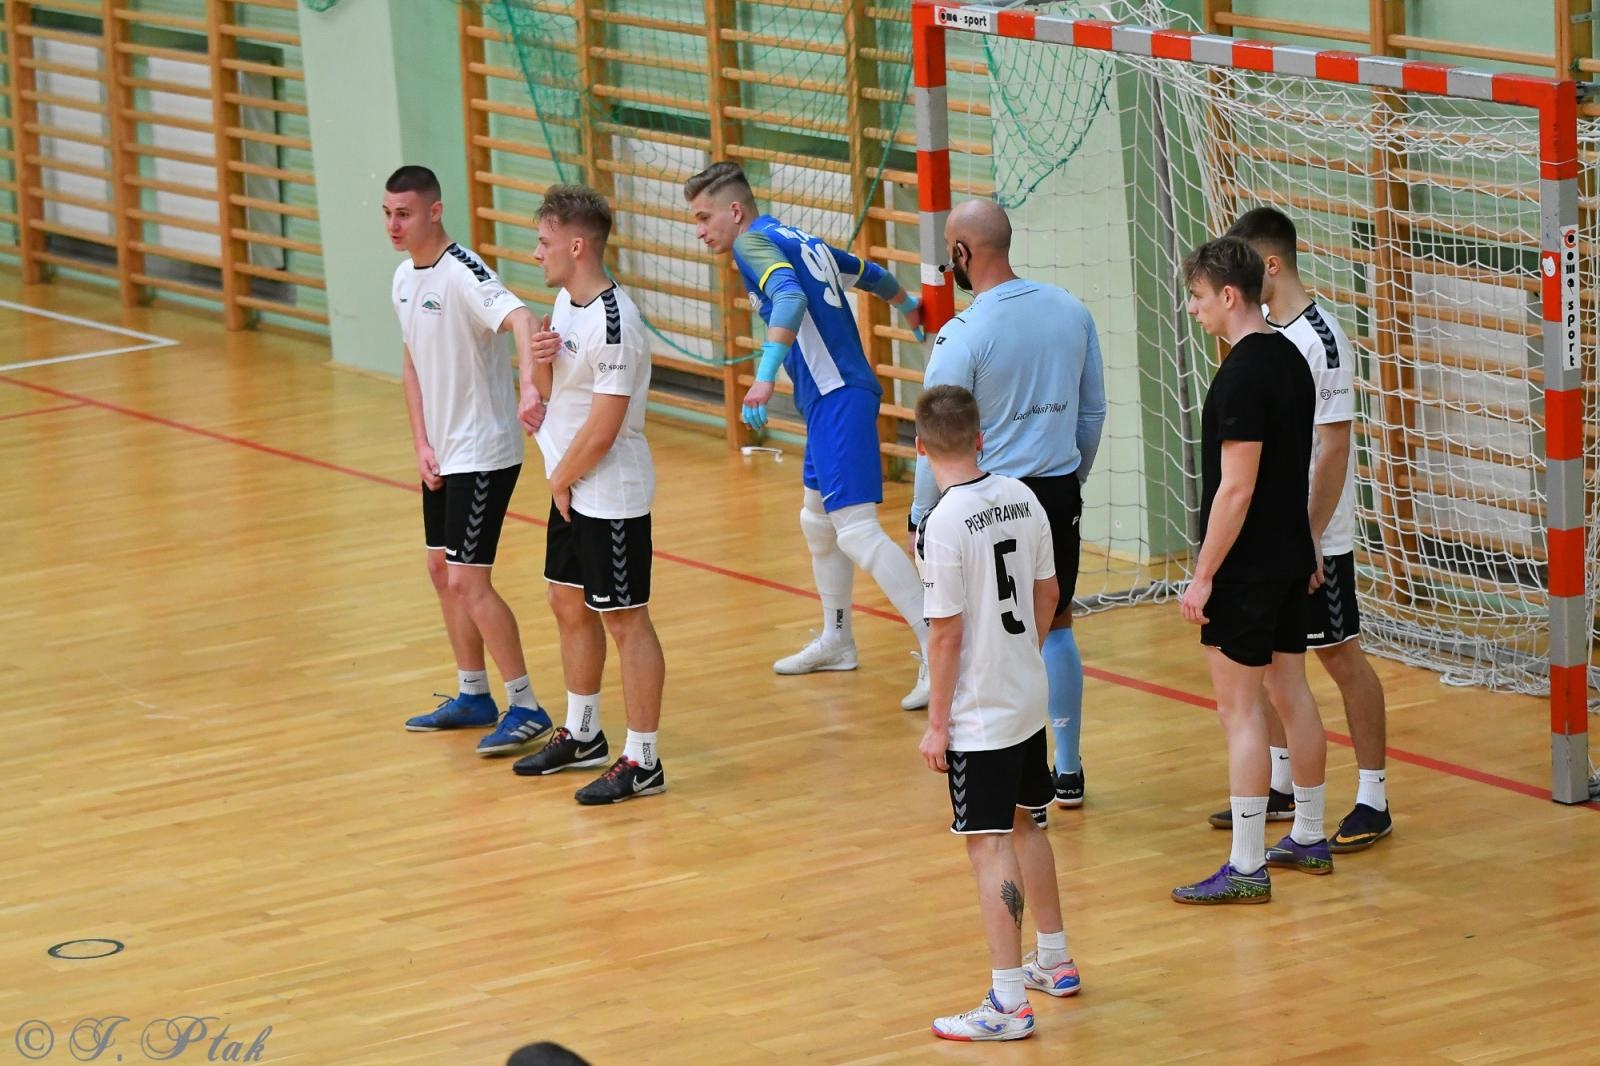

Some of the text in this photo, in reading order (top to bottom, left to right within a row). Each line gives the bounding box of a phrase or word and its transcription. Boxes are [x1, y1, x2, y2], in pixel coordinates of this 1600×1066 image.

[964, 15, 987, 27] sport
[1567, 301, 1575, 366] sport
[994, 501, 1032, 523] RAWNIK
[993, 538, 1026, 635] 5
